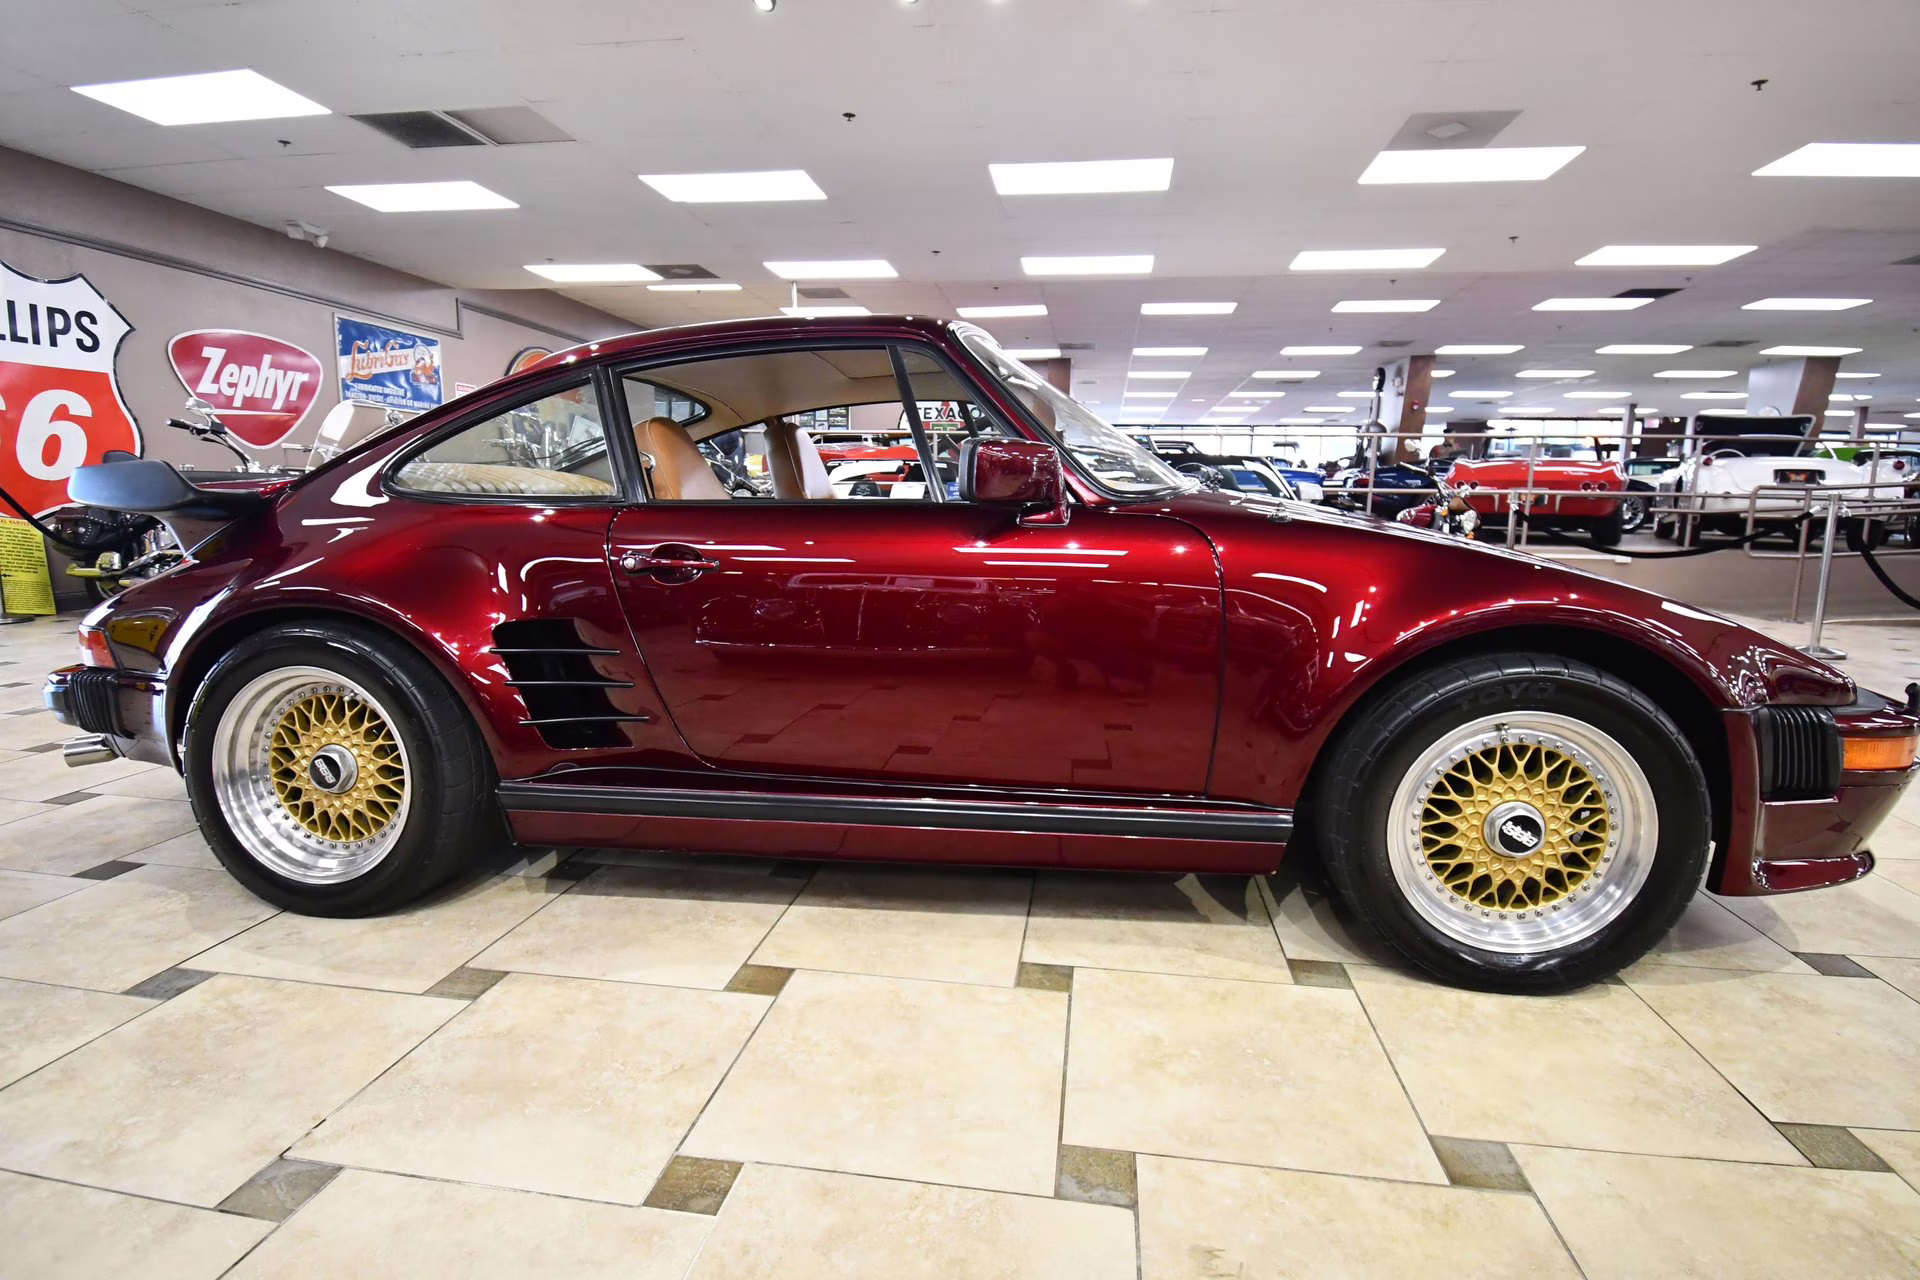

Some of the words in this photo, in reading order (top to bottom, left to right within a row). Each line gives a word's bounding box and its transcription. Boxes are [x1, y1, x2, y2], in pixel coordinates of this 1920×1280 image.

[0, 299, 100, 353] LIPS
[196, 346, 310, 410] Zephyr
[917, 406, 982, 420] EXAO
[0, 389, 93, 481] 6
[1455, 681, 1556, 712] TOYO
[314, 758, 337, 784] BBS
[1501, 820, 1539, 848] BBS
